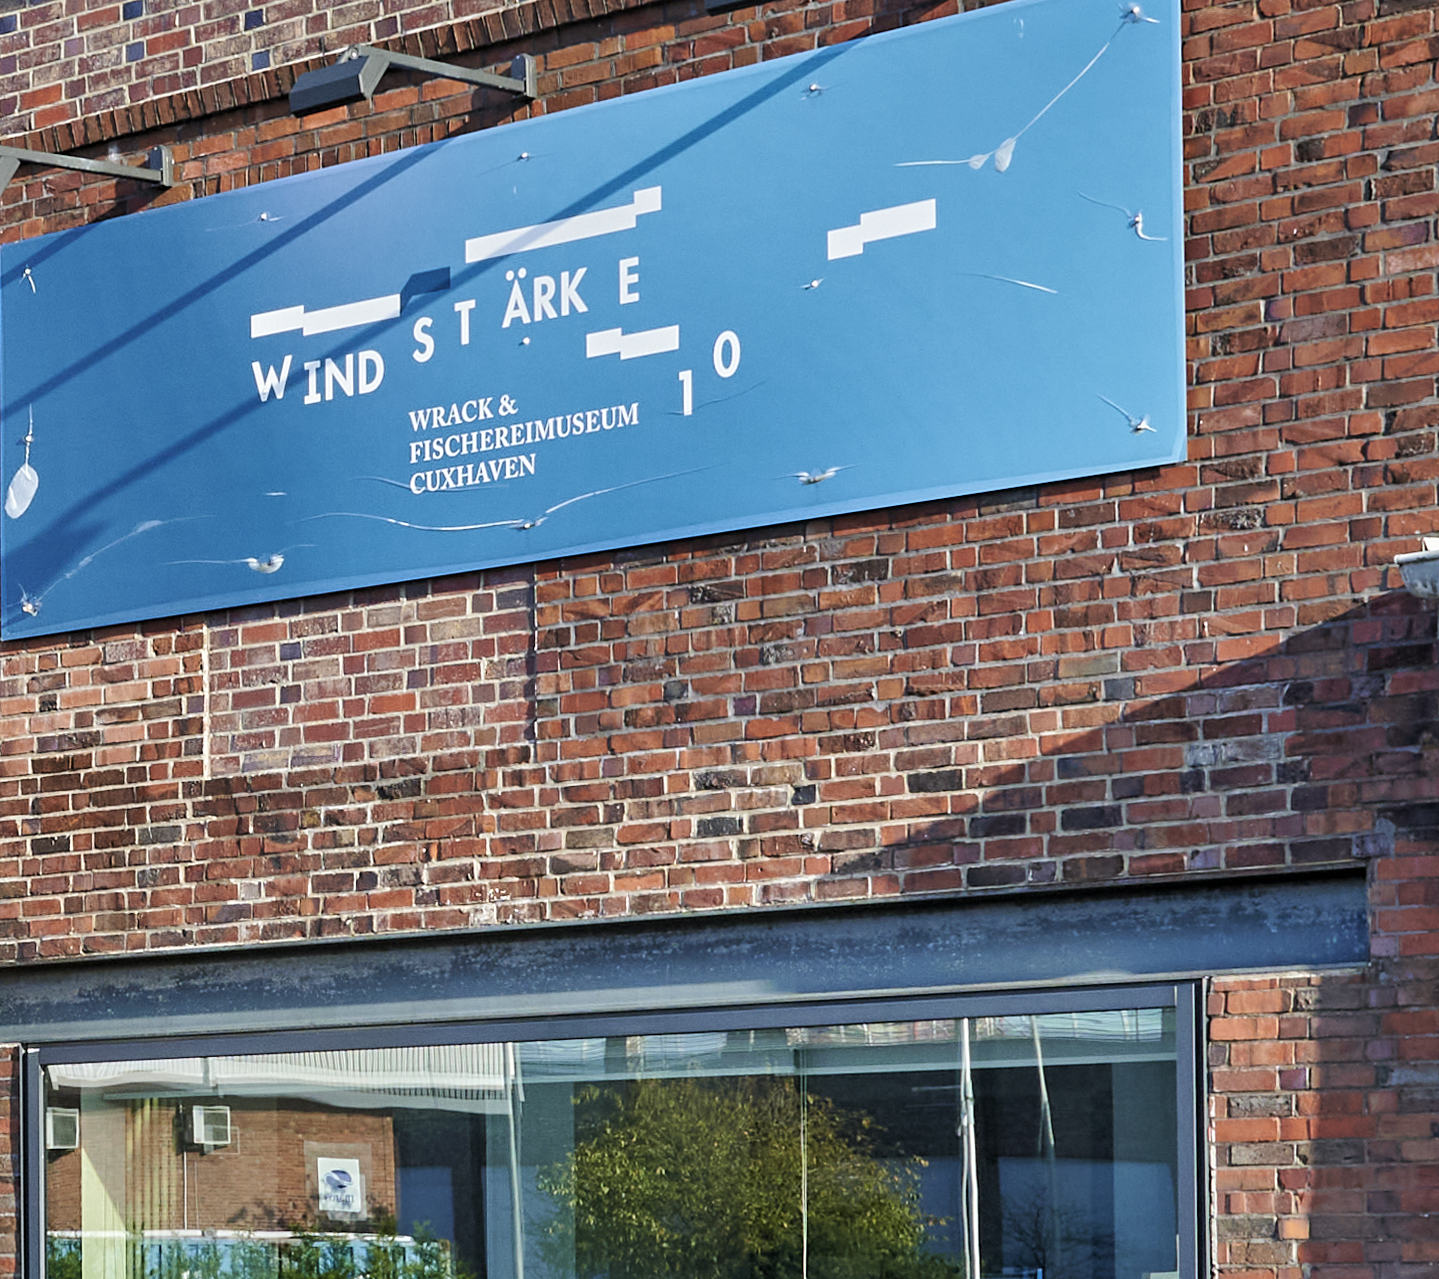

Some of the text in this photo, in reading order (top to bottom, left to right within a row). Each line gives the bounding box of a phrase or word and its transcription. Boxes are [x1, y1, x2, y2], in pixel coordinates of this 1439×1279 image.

[408, 393, 520, 433] WRACK &
[408, 402, 640, 465] FISCHEREIMUSEUM
[408, 452, 537, 496] CUXHAVEN
